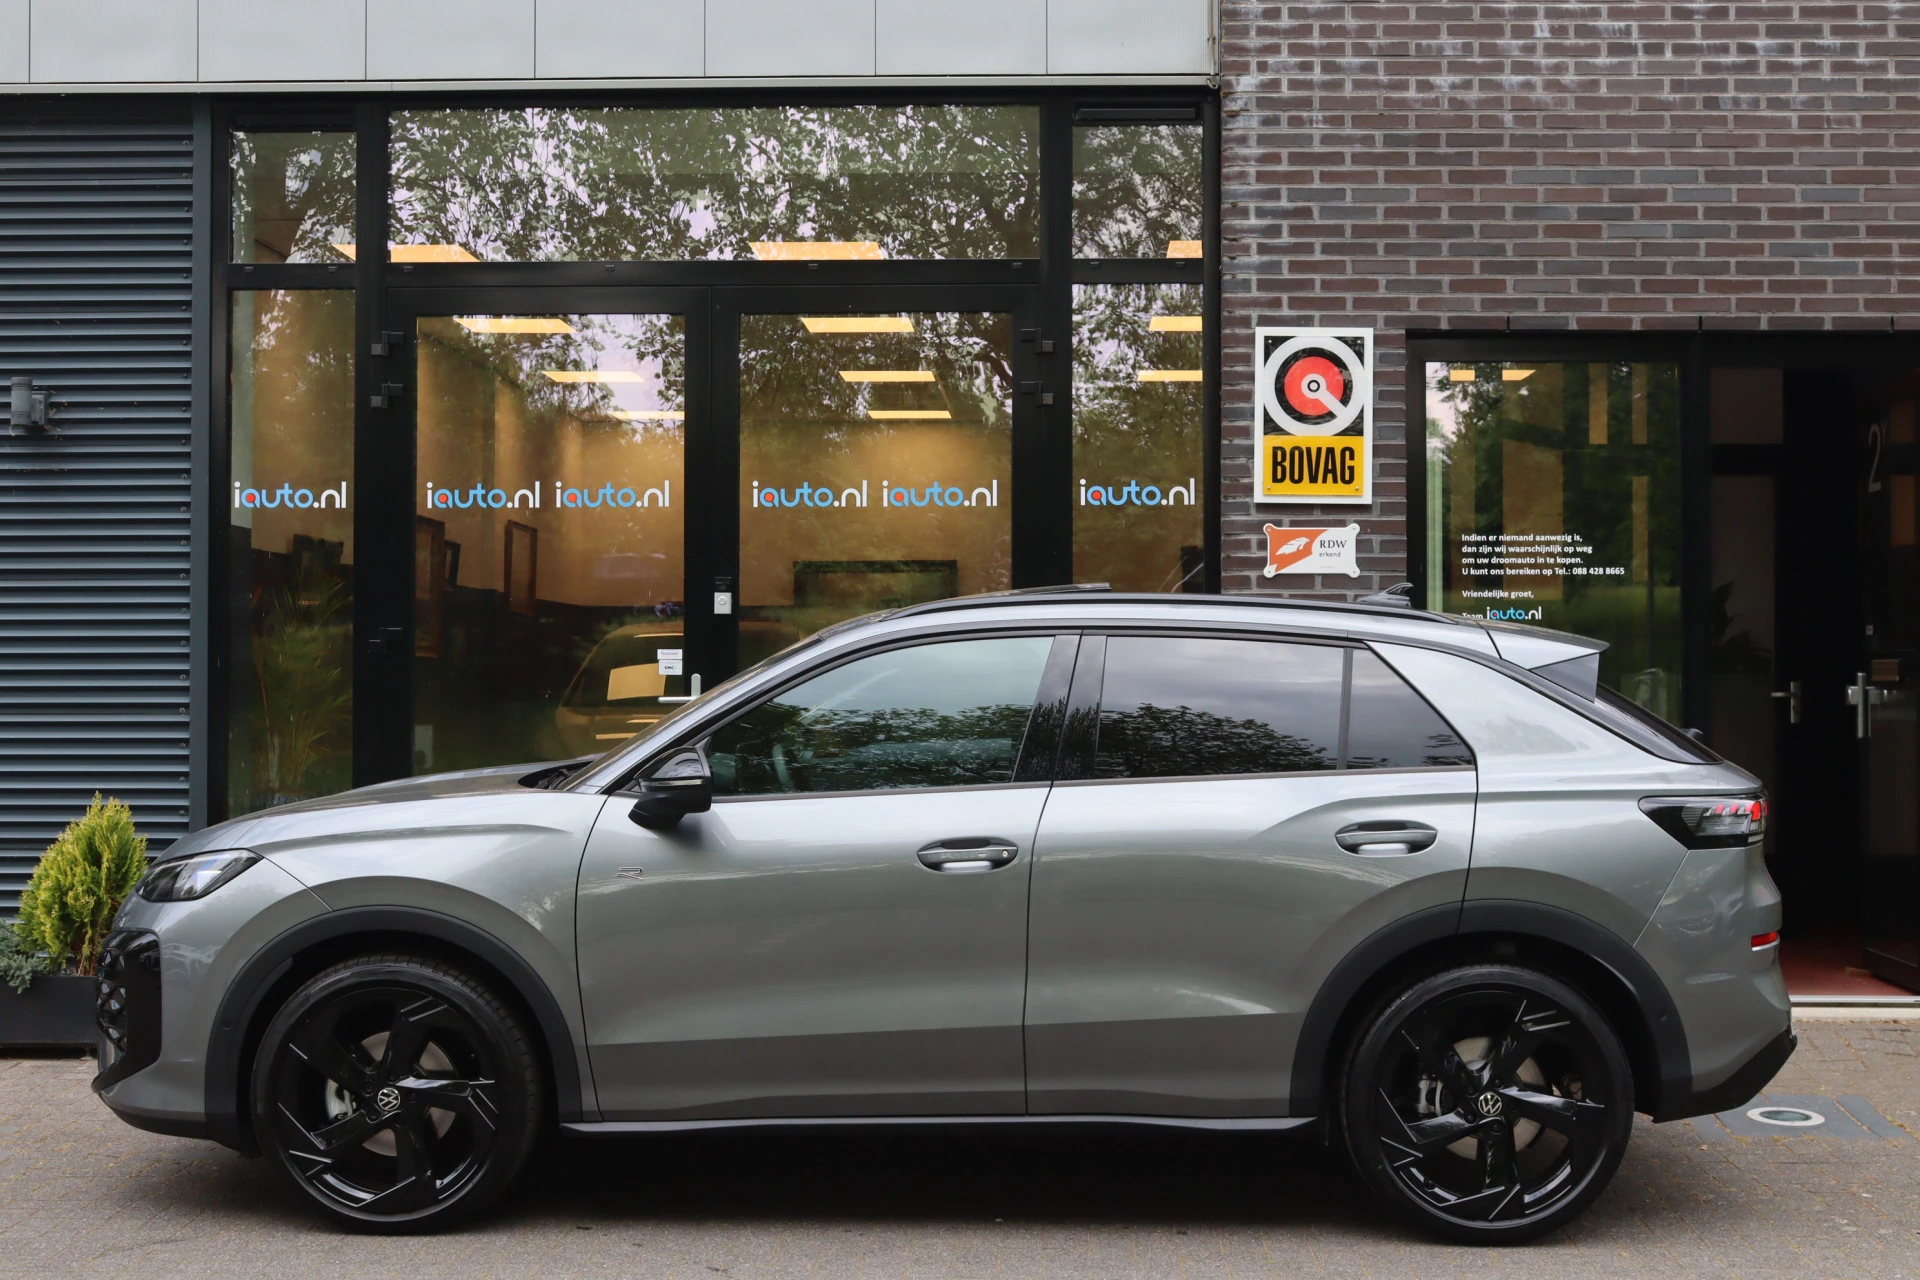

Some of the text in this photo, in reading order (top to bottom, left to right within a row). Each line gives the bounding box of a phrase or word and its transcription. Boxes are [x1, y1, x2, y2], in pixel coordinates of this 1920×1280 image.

[1271, 446, 1355, 485] BOVAG
[234, 481, 347, 508] iauto.nl
[426, 481, 541, 509] iauto.nl
[555, 480, 670, 508] iauto.nl
[752, 480, 868, 508] iauto.nl
[882, 479, 998, 507] iauto.nl
[1080, 478, 1196, 506] iauto.nl
[1319, 540, 1347, 549] RDW
[1461, 533, 1487, 542] Indien
[1498, 533, 1534, 542] niemand
[1535, 533, 1573, 543] aanwezig
[1573, 533, 1583, 542] is,
[1461, 545, 1593, 555] dan zijn wij waarschijnlijk op weg
[1490, 556, 1536, 564] droomauto
[1536, 556, 1545, 564] in
[1556, 556, 1584, 565] kopen.
[1461, 567, 1469, 576] U
[1470, 567, 1488, 576] kunt
[1506, 567, 1541, 576] bereiken
[1542, 569, 1553, 577] op
[1554, 567, 1571, 576] Tel.:
[1572, 567, 1588, 576] 088
[1588, 567, 1605, 576] 428
[1605, 567, 1625, 576] 8665
[1461, 590, 1535, 599] Vriendelijke groet,
[1486, 606, 1542, 620] iauto.nl
